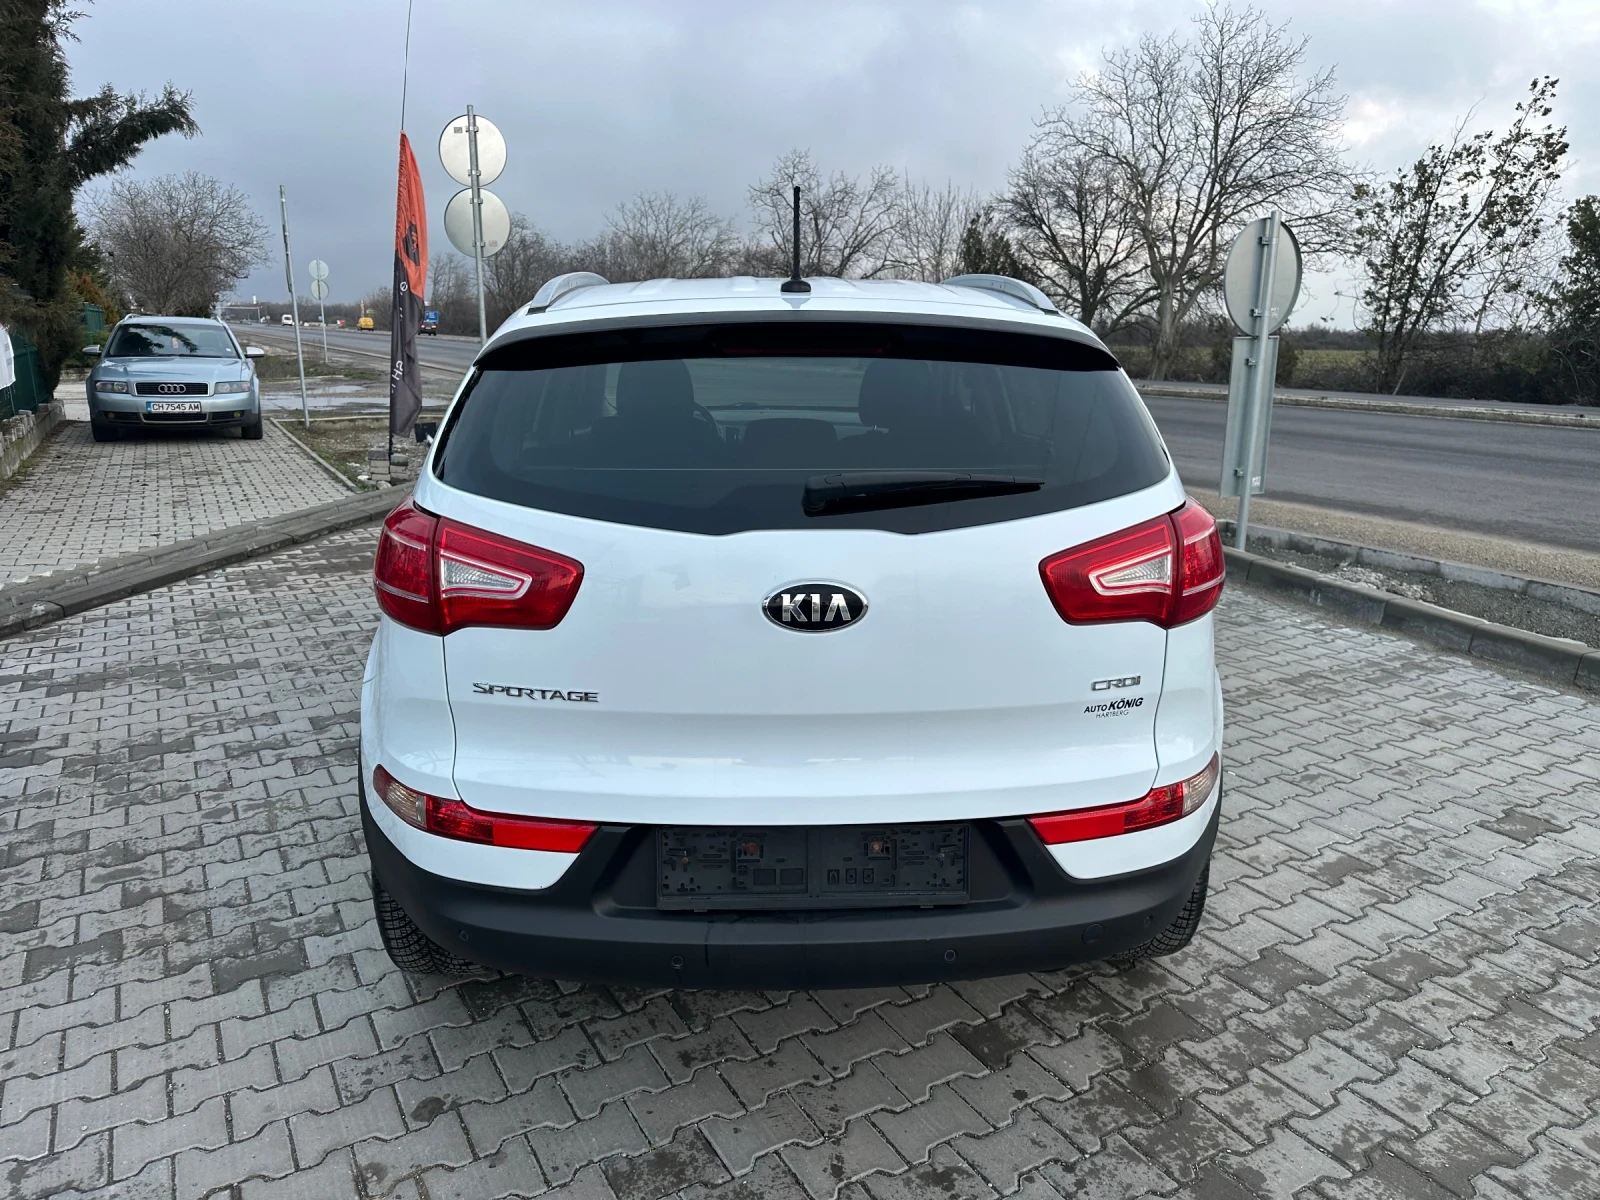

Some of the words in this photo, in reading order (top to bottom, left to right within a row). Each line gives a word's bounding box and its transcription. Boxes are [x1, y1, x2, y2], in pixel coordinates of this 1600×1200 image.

[165, 403, 187, 411] 7545
[780, 593, 852, 622] KIA
[472, 682, 599, 703] SPORTAGE
[1083, 704, 1108, 714] AUTO
[1108, 697, 1144, 711] KÖNIG
[1095, 709, 1129, 719] HARTBERG
